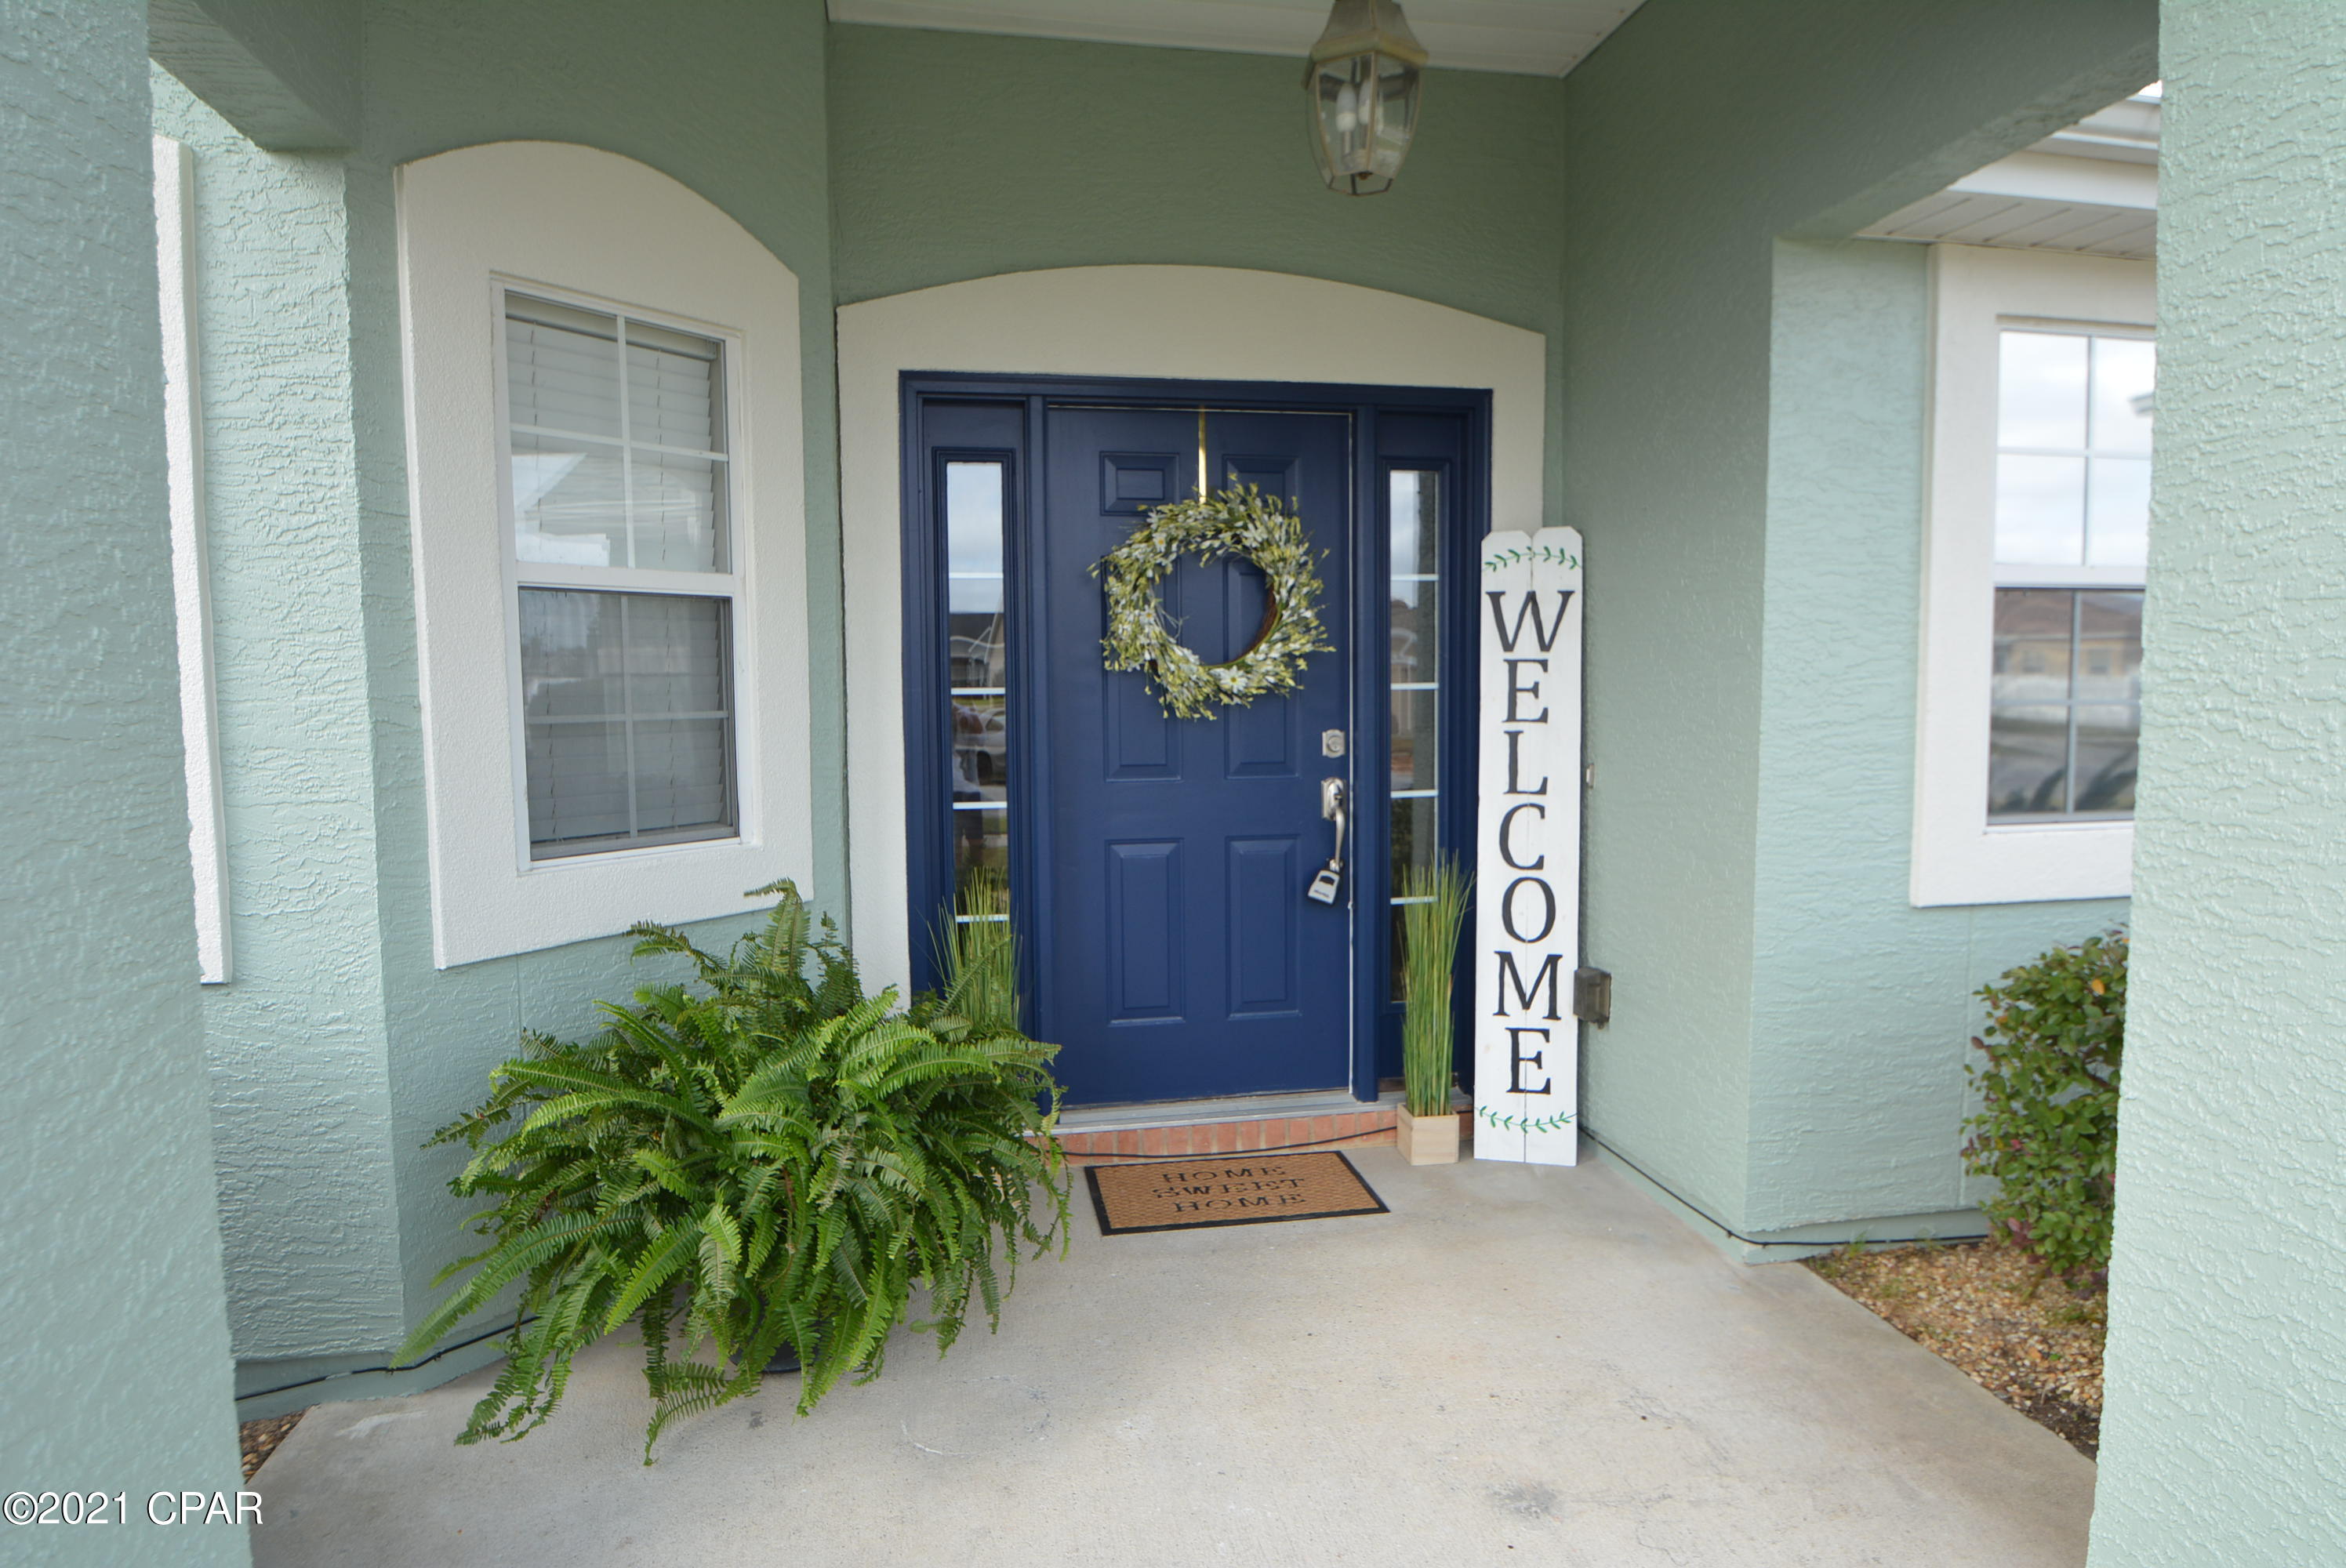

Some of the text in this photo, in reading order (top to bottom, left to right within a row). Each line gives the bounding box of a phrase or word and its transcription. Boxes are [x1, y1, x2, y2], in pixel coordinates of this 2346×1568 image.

[1484, 590, 1575, 1094] WELCOME
[1162, 1166, 1287, 1182] HOME
[1152, 1178, 1306, 1198] SWEET
[1174, 1193, 1306, 1212] HOME
